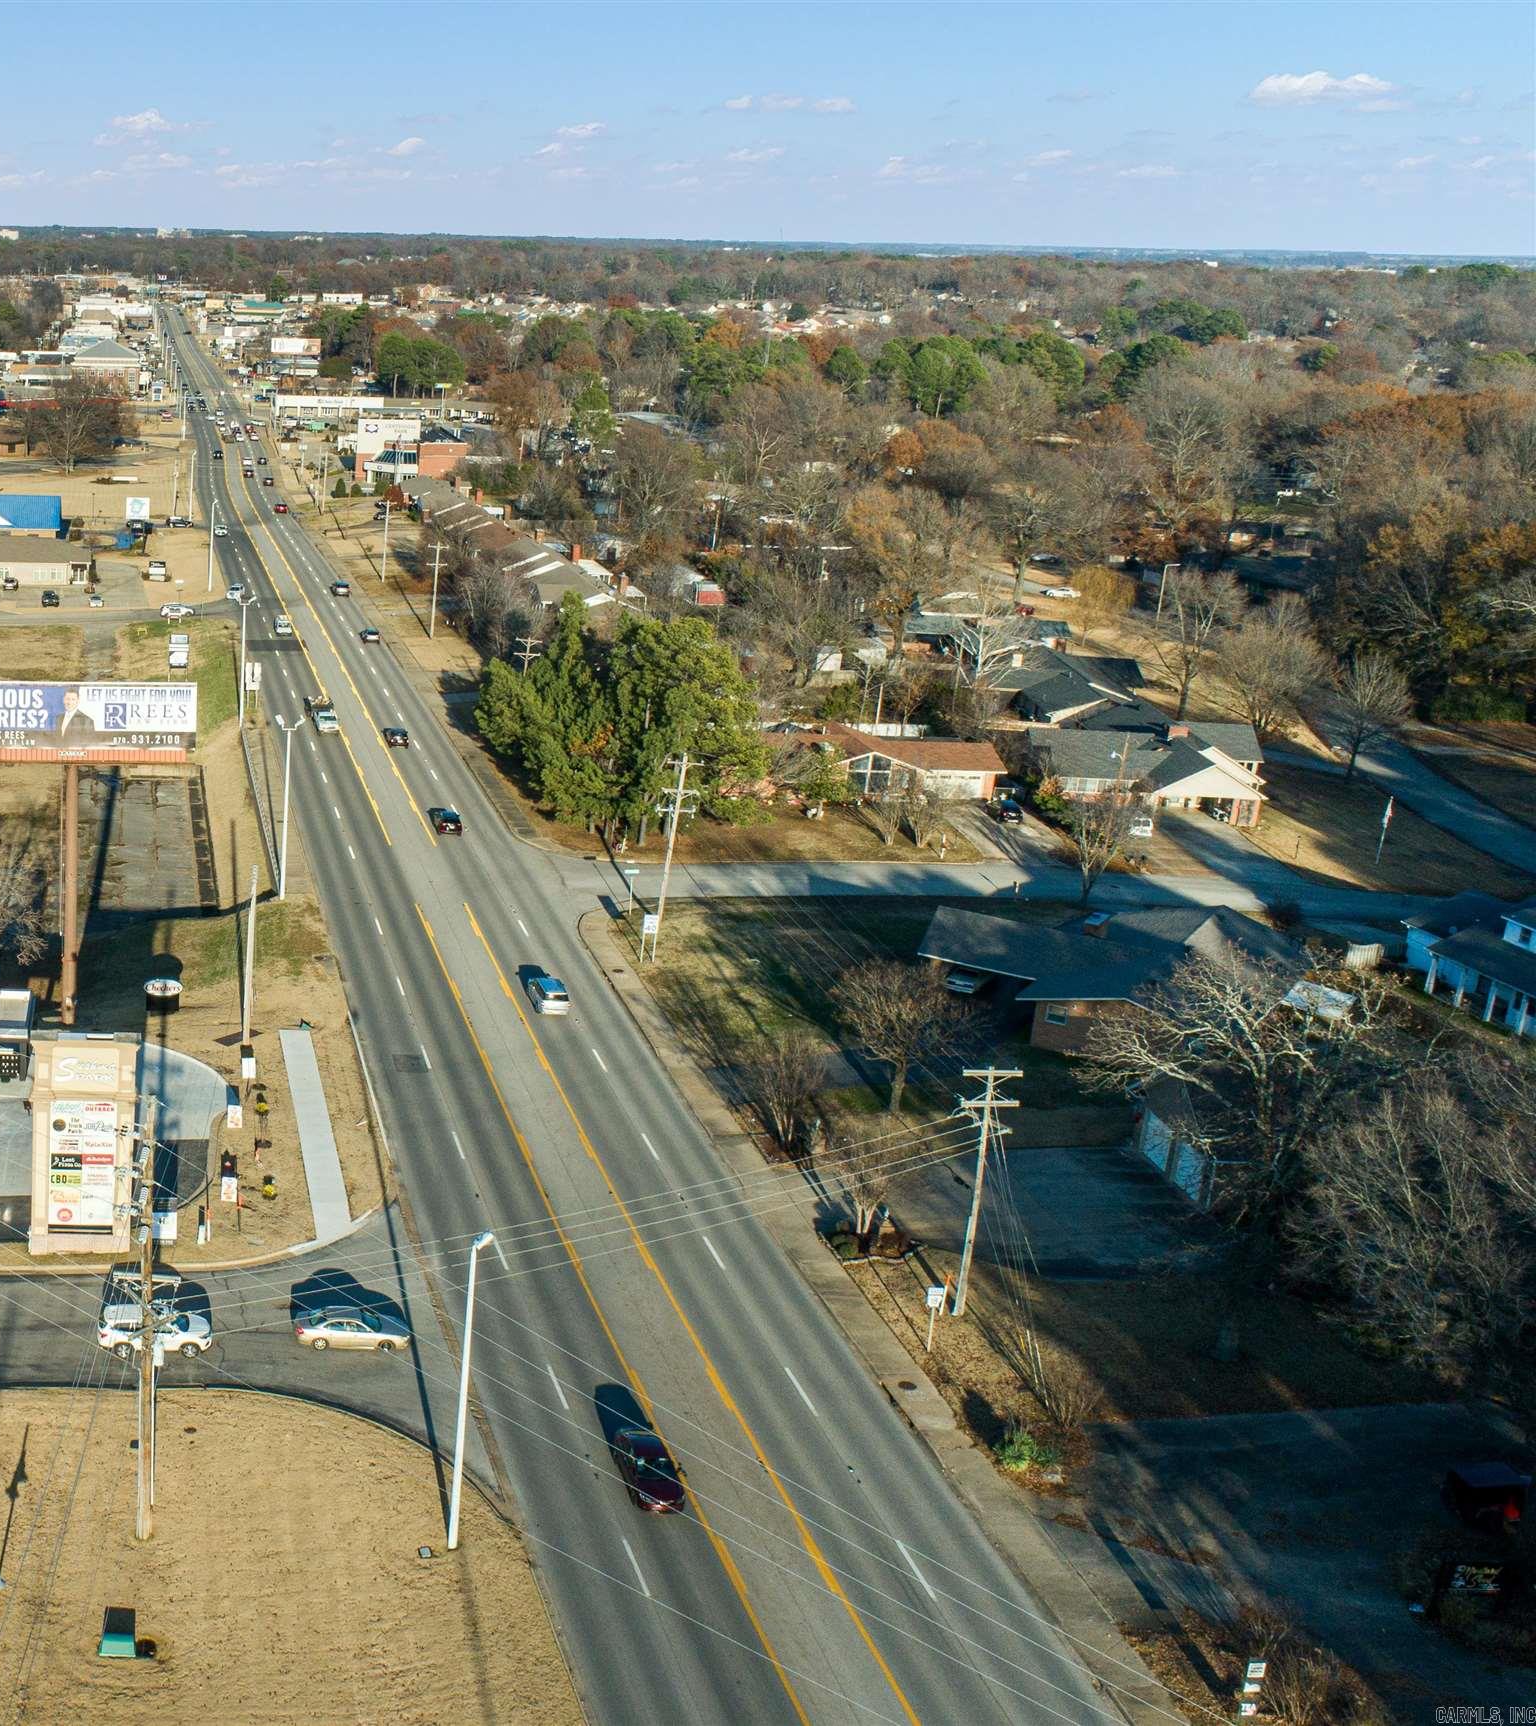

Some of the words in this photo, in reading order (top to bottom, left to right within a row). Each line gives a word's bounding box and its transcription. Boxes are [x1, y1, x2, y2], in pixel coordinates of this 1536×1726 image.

[87, 688, 102, 701] LET
[106, 688, 117, 701] US
[121, 688, 146, 701] FIGHT
[150, 688, 167, 701] FOR
[130, 704, 188, 719] REES
[4, 731, 25, 739] REES
[145, 983, 182, 992] Checkers
[50, 1174, 67, 1184] CBD
